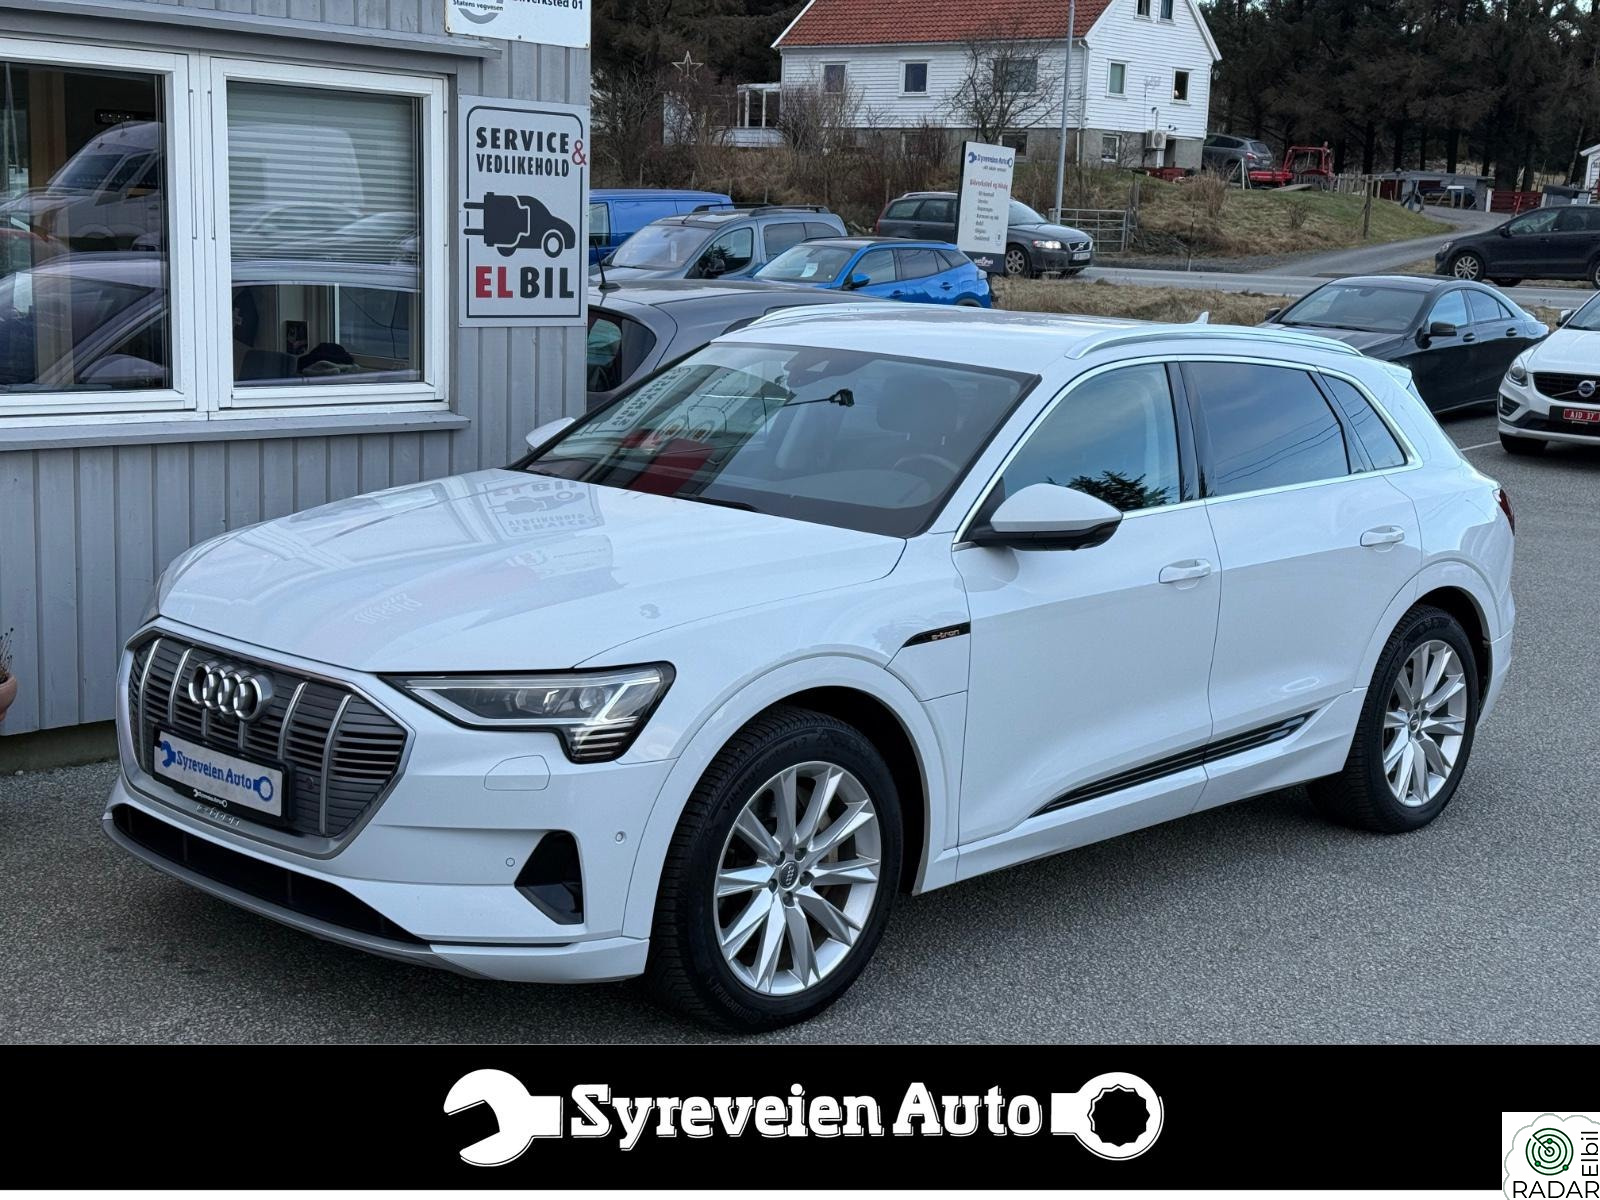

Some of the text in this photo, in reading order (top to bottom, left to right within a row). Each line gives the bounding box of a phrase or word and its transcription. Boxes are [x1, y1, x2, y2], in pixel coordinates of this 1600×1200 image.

[572, 0, 584, 10] 01
[475, 126, 588, 166] SERVICE &
[475, 153, 570, 178] VEDLIKEHOLD
[176, 750, 252, 790] Syreveien Auto
